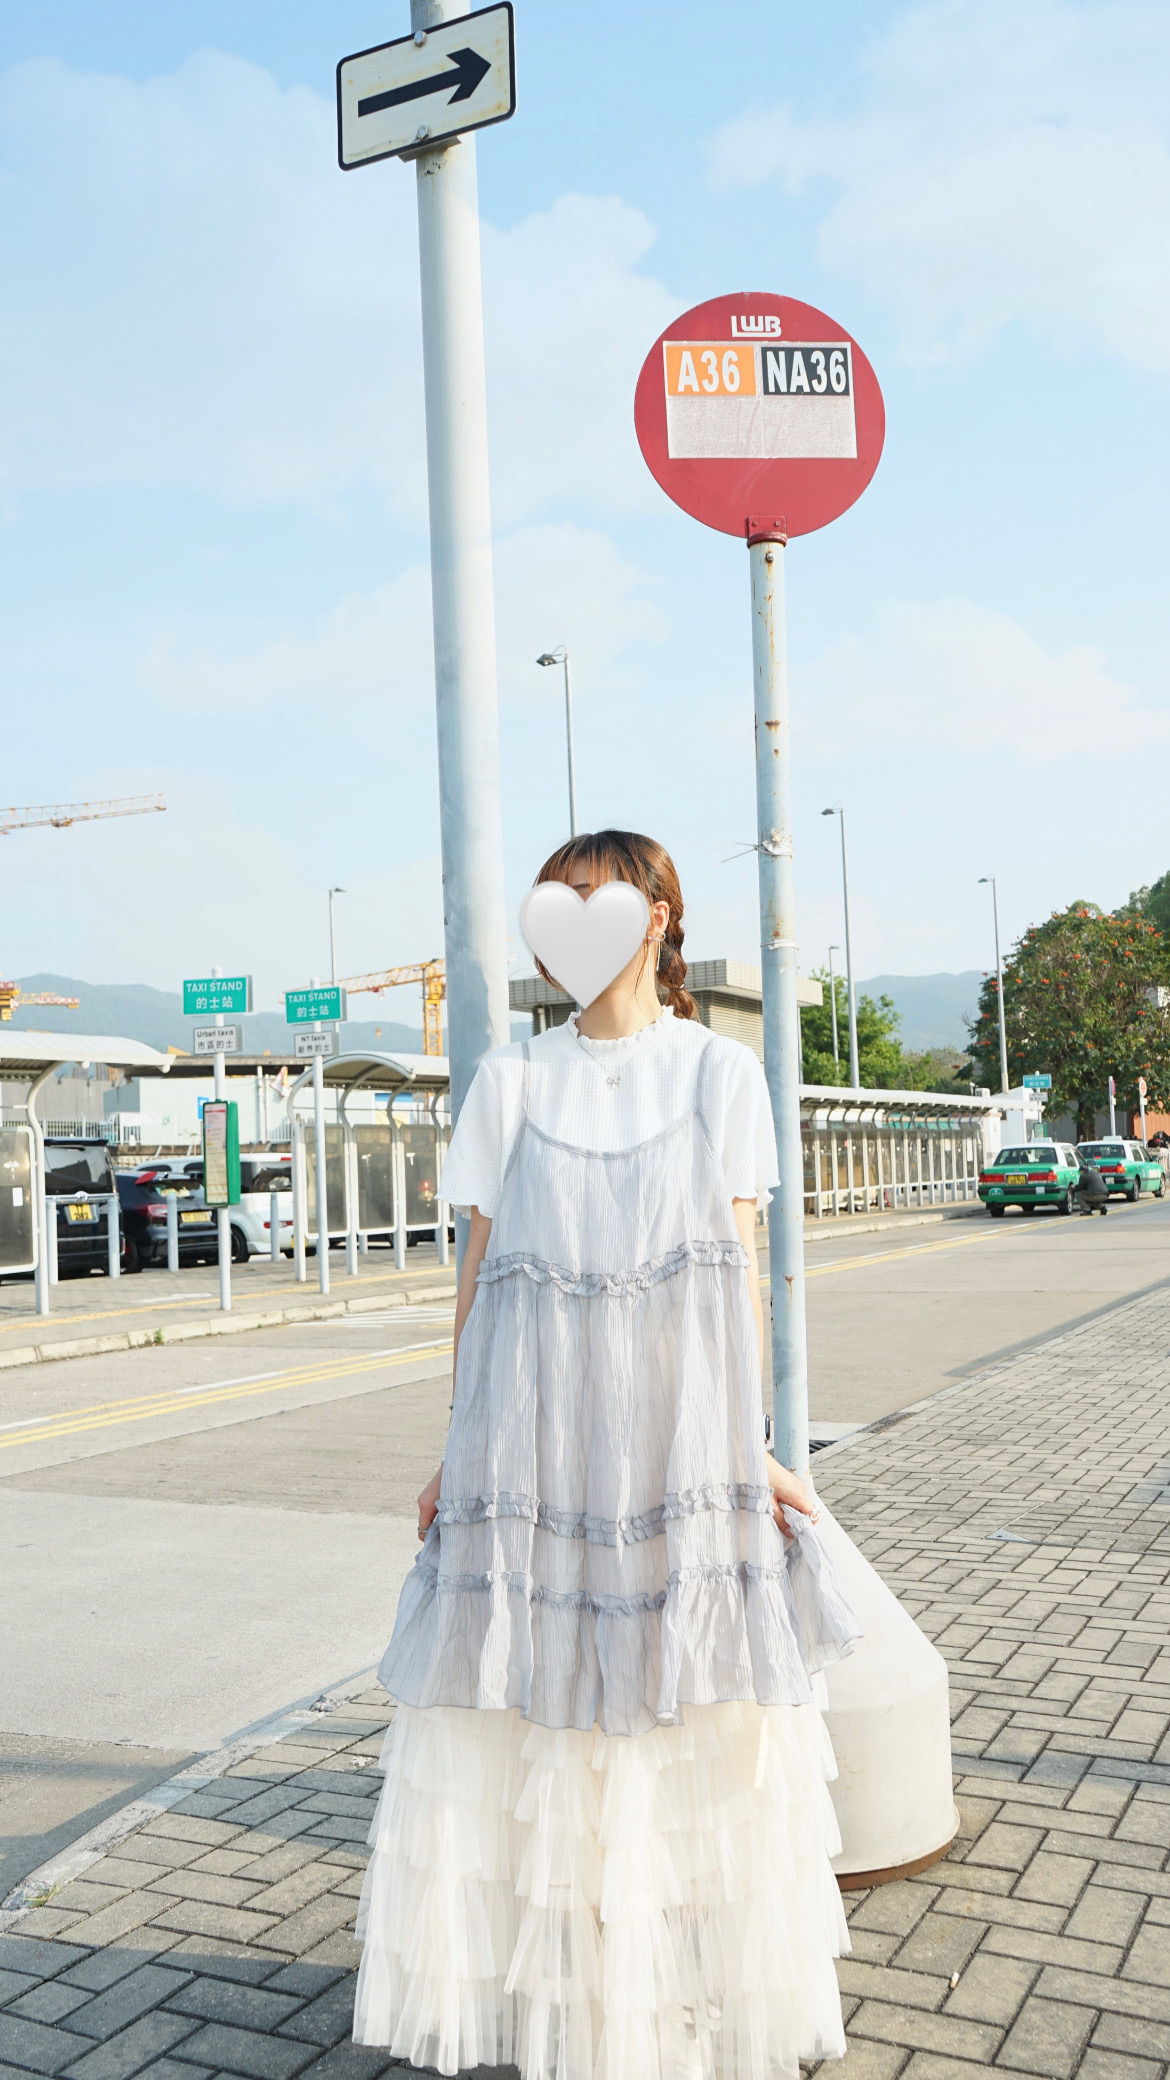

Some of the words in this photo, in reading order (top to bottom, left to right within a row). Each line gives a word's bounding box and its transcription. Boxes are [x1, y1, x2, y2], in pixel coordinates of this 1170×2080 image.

[731, 315, 782, 337] LWB
[677, 350, 741, 393] A36
[766, 350, 847, 393] NA36
[186, 983, 207, 993] TAXI
[210, 981, 243, 992] STAND
[196, 995, 233, 1011] 的士站
[288, 994, 307, 1003] TAXI
[308, 991, 337, 1002] STAND
[297, 1004, 329, 1018] 的士站
[196, 1030, 216, 1038] Urban
